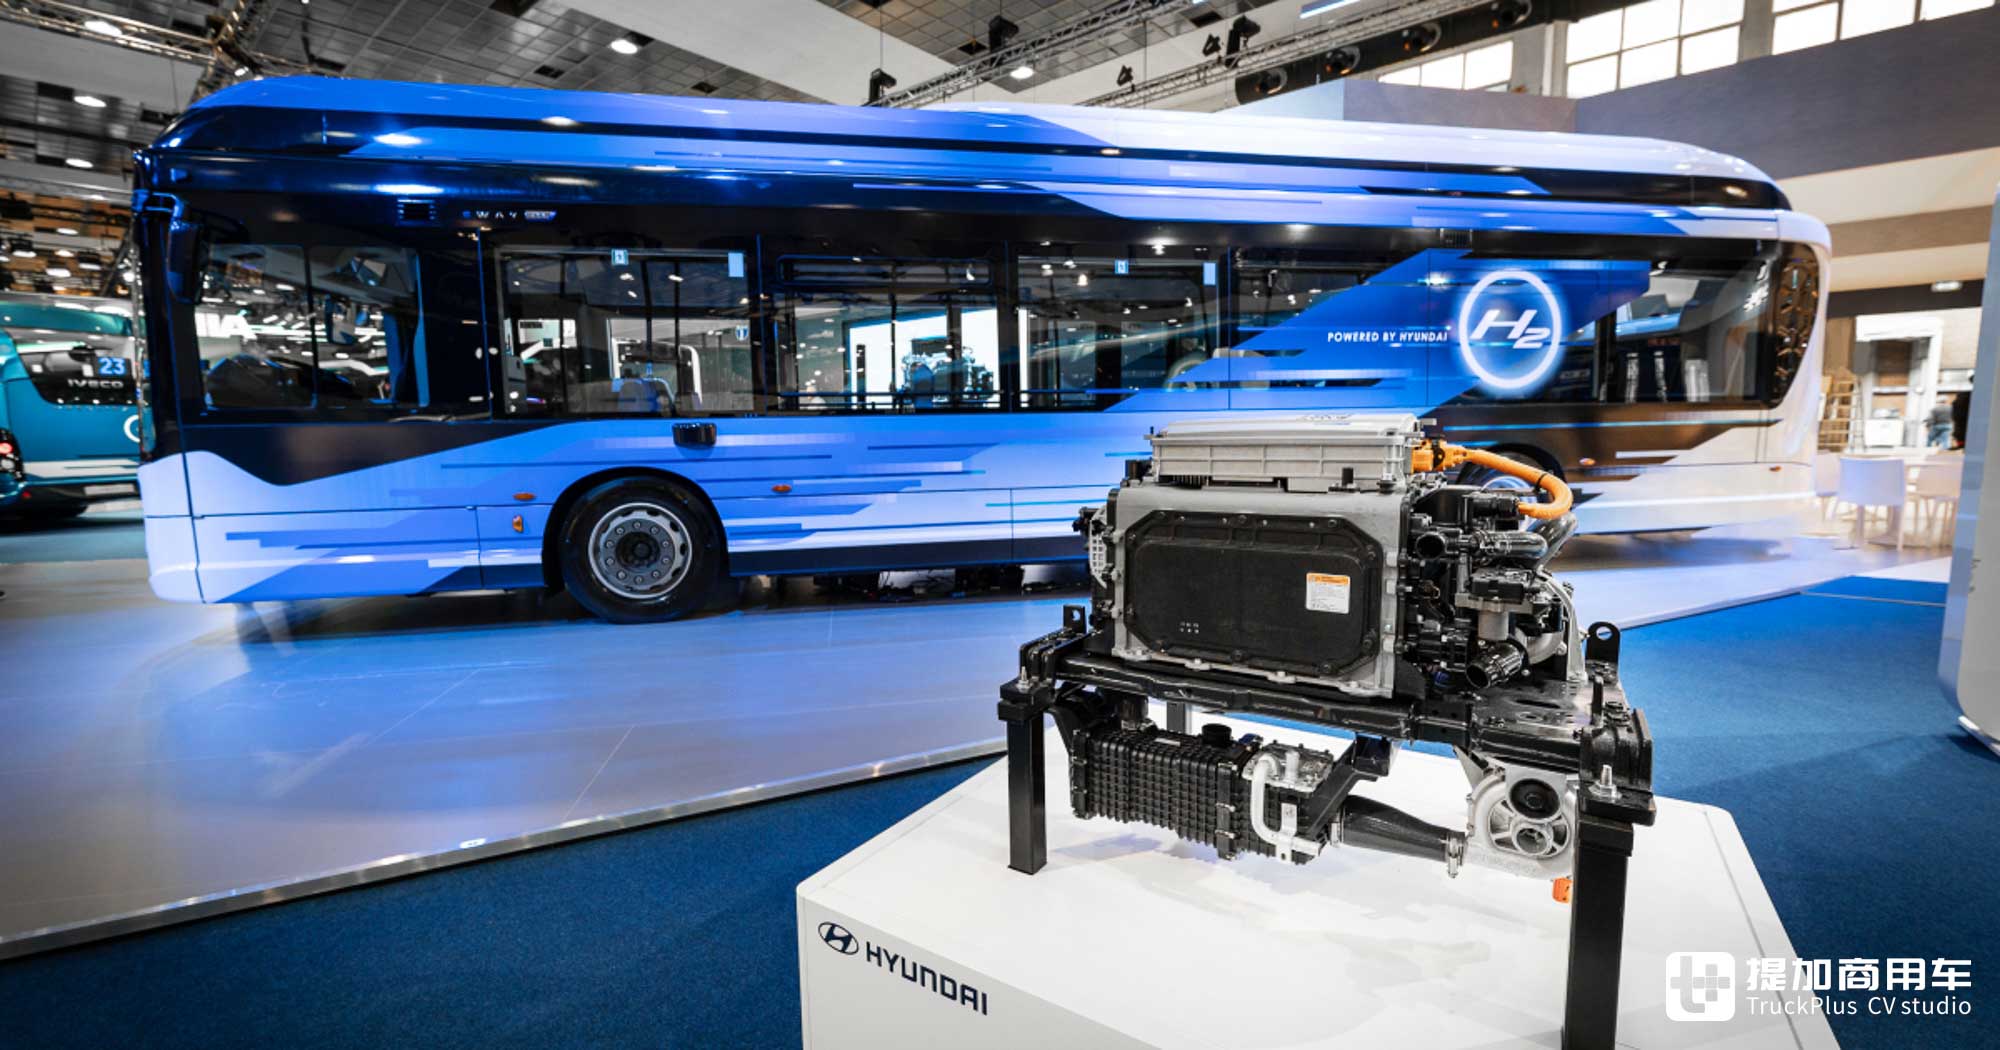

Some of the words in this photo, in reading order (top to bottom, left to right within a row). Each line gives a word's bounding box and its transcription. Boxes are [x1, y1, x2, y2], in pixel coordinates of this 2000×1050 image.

[1327, 331, 1379, 343] POWERED
[1383, 331, 1396, 343] BY
[1400, 331, 1448, 342] HYUNDAI
[99, 357, 125, 375] 23
[67, 378, 124, 389] IVECO
[866, 941, 988, 1016] HYUNDAI
